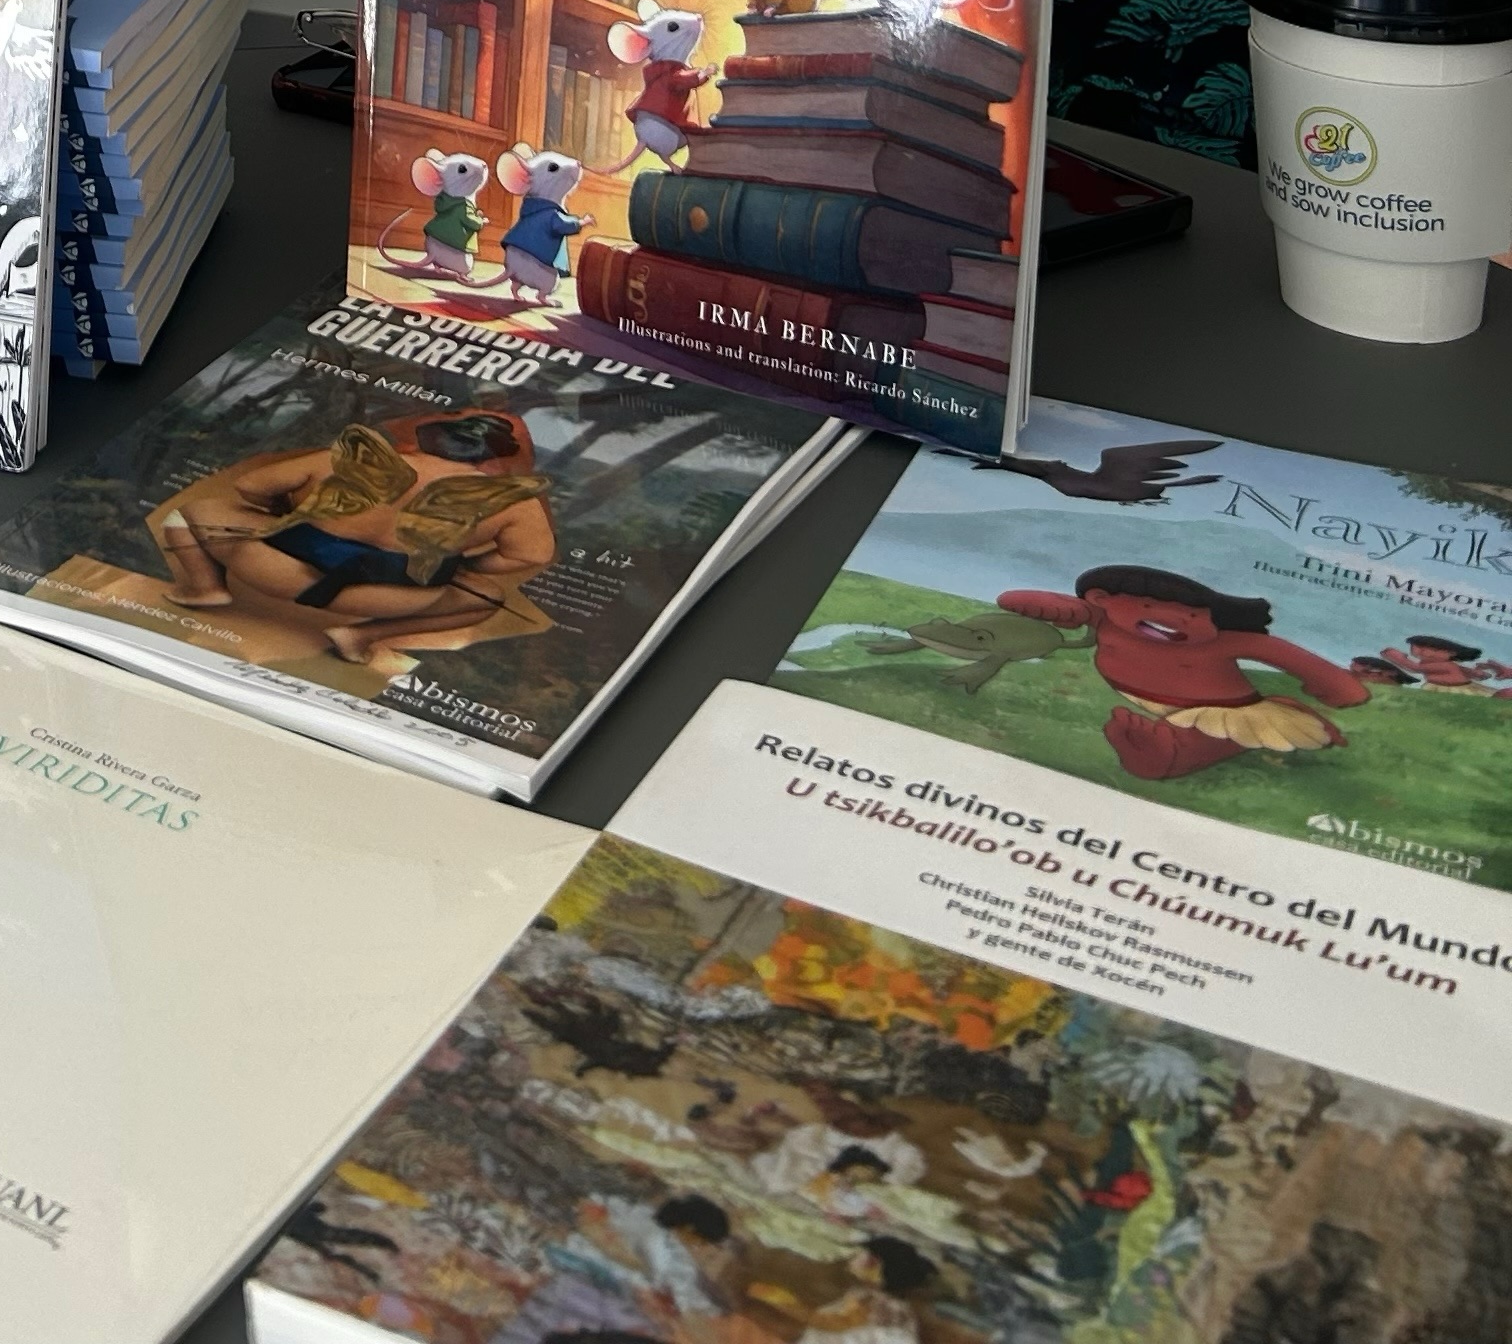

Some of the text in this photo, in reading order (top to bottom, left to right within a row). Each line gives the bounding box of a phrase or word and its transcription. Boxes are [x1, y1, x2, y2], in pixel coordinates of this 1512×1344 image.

[1316, 122, 1354, 155] 21
[1268, 159, 1432, 214] We grow coffee
[1291, 195, 1331, 219] sow
[1336, 207, 1445, 233] inclusion
[307, 310, 543, 388] GUERRERO
[698, 301, 918, 370] IRMA BERNABE
[270, 346, 455, 408] Hermes Millán
[618, 318, 979, 420] Illustrations and translation: Ricardo Sánchez
[1254, 560, 1390, 600] Ilustraciones:
[1296, 553, 1372, 584] Trini
[181, 617, 243, 644] Calvillo
[382, 688, 431, 710] casa
[430, 704, 520, 742] editorial
[386, 673, 537, 733] Abismos
[30, 727, 201, 802] Cristina Rivera Garza
[754, 731, 1356, 931] Relatos divinos del Centro del
[1306, 813, 1483, 869] Abismos
[784, 776, 815, 801] U
[1072, 867, 1099, 888] u
[1109, 878, 1309, 954] Chúumuk
[918, 871, 1015, 912] Christian
[1123, 935, 1254, 985] Rasmussen
[1025, 885, 1156, 937] Silvia Terán
[945, 899, 1208, 991] Pedro Pablo Chuc Pech
[966, 928, 1166, 997] y gente de Xocén
